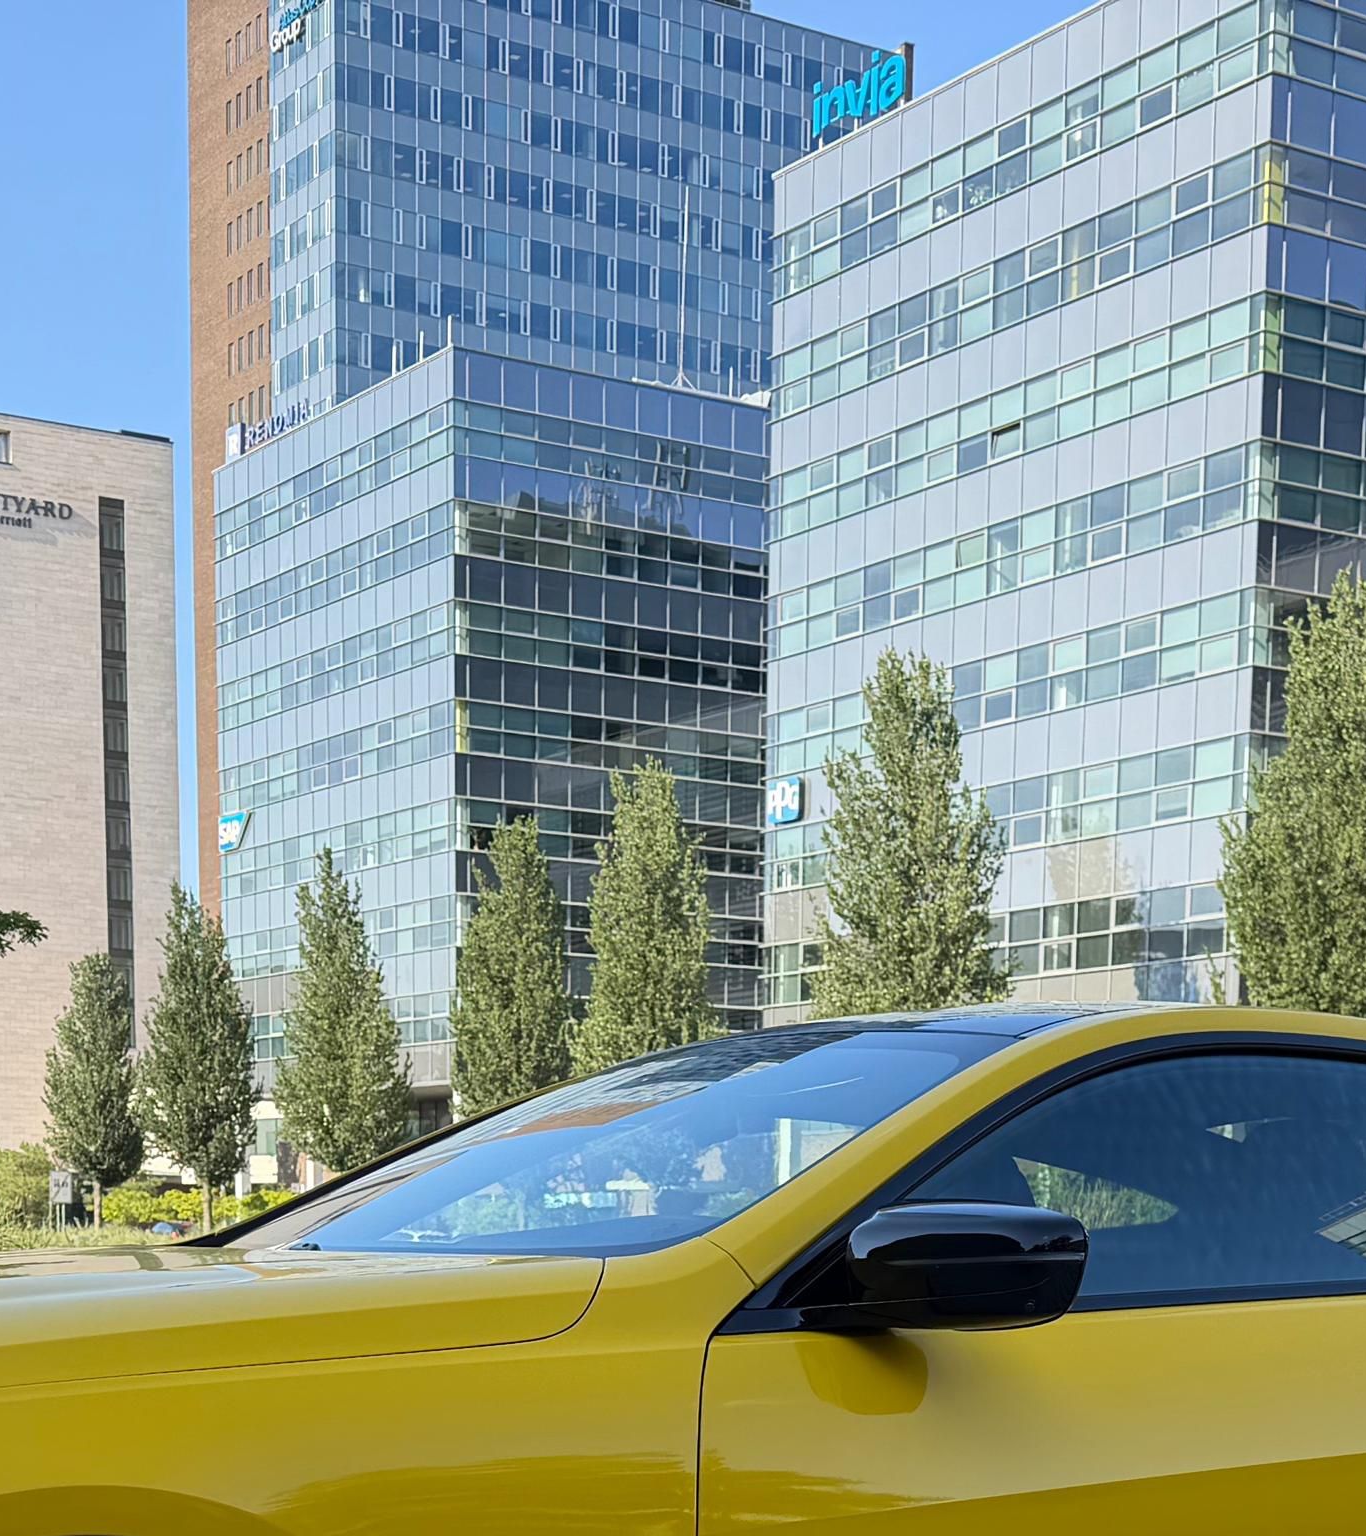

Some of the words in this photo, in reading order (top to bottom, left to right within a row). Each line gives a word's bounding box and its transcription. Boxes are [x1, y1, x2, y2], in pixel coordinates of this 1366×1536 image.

[270, 17, 301, 52] Group
[812, 49, 906, 138] invia
[245, 398, 310, 450] RENOMIA
[766, 779, 800, 819] PPG
[218, 819, 242, 846] SAP
